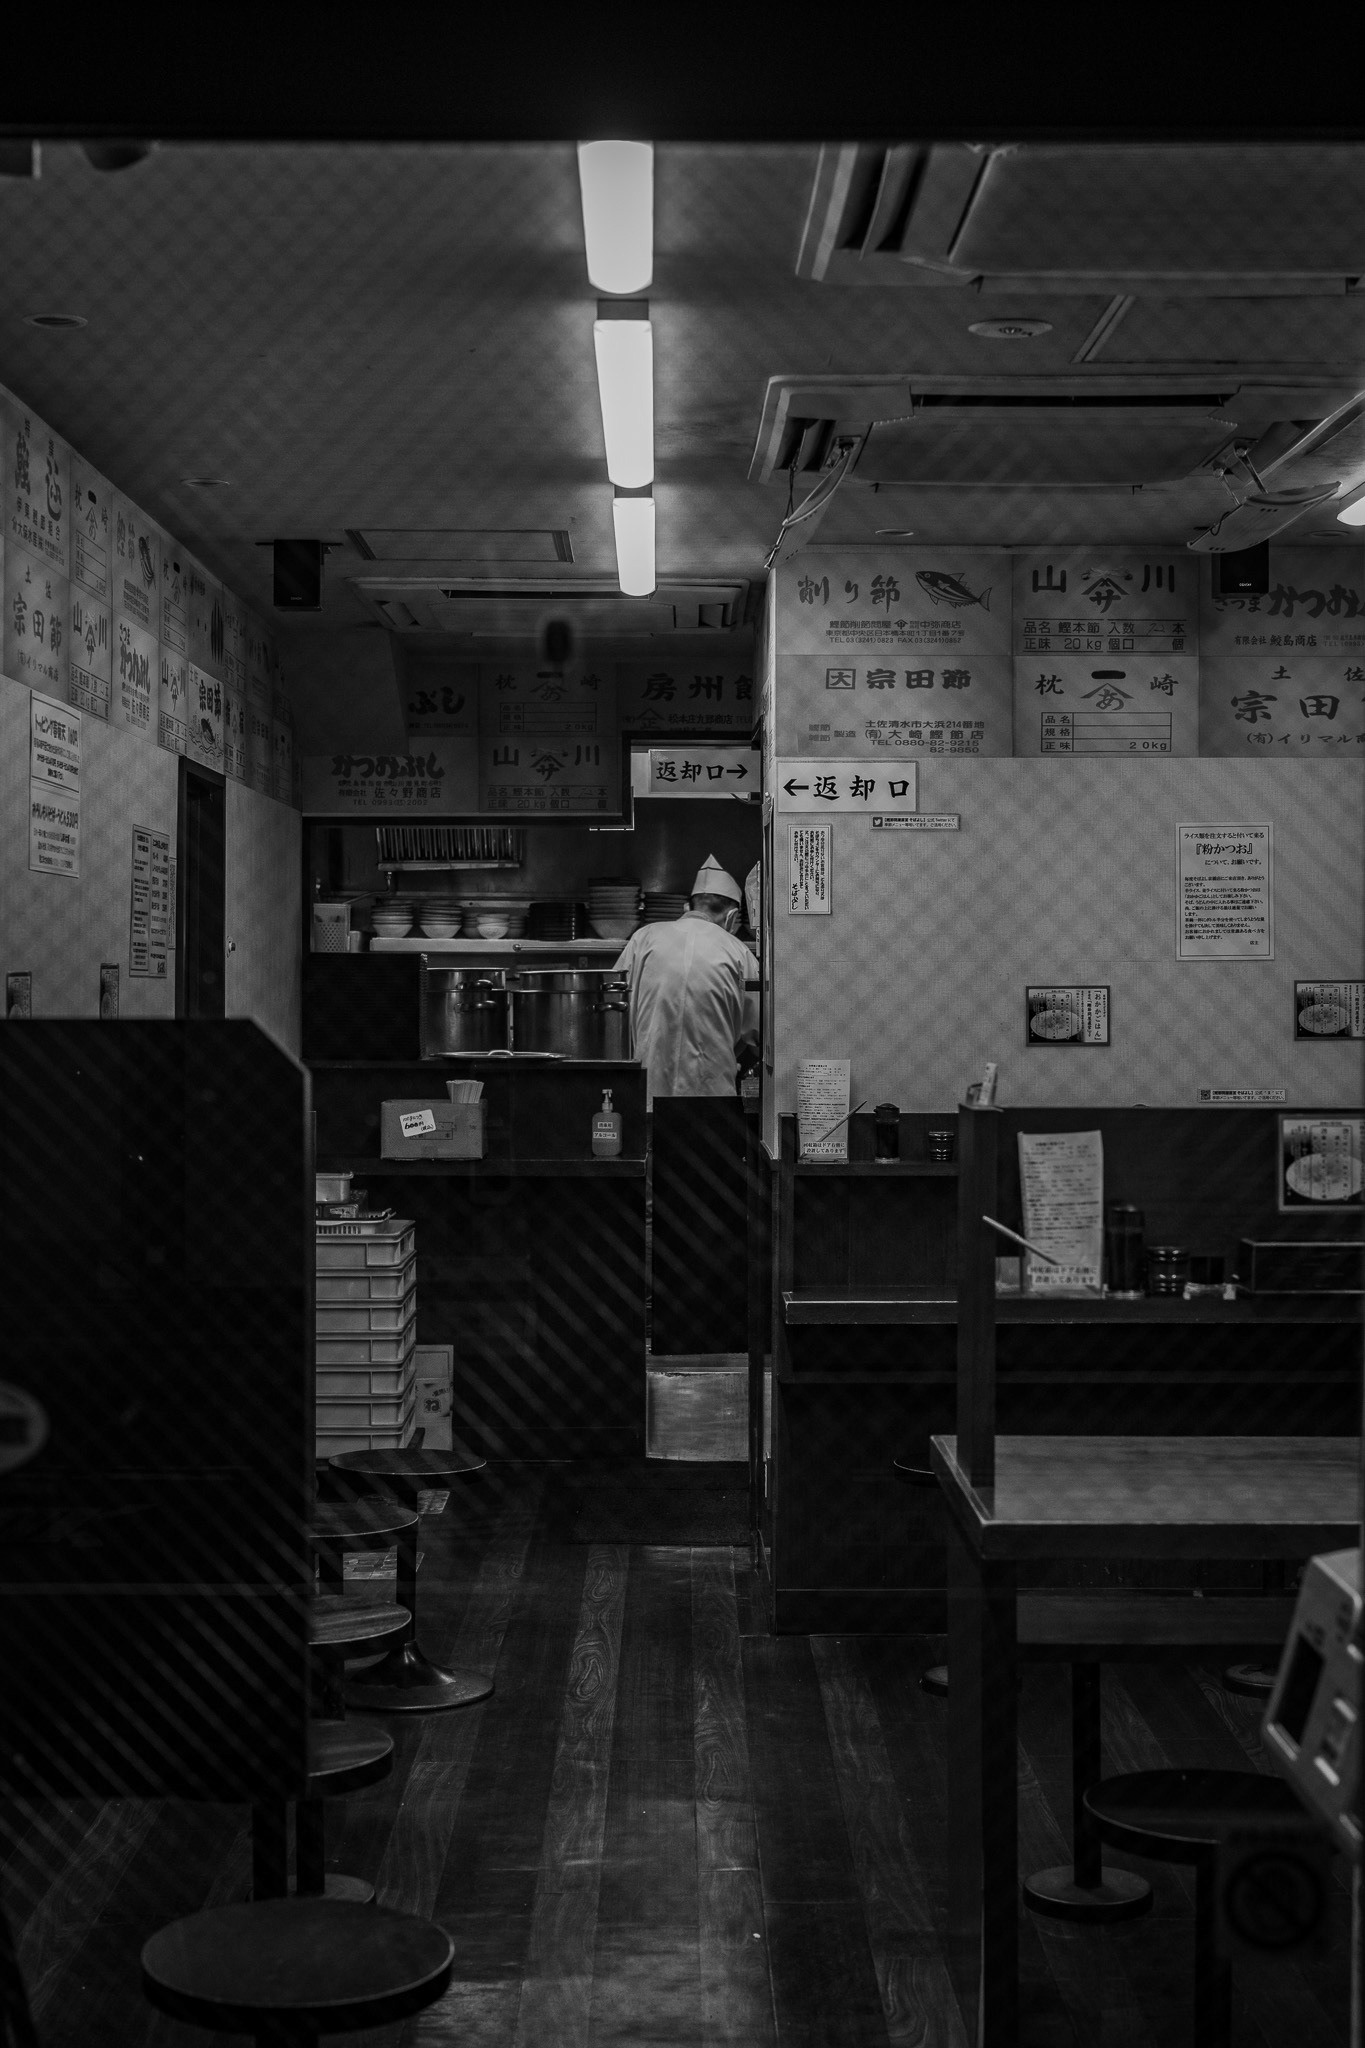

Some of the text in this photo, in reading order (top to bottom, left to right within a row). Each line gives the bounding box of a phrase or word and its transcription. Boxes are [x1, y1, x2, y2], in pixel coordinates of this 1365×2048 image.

[797, 574, 901, 613] 削り節
[1214, 598, 1262, 613] さつま
[1024, 621, 1051, 634] 品名
[1058, 621, 1101, 634] 鰹本節
[1108, 621, 1135, 634] 入数
[1024, 637, 1051, 650] 正味
[1108, 638, 1135, 650] 個口
[865, 668, 972, 690] 宗田節
[1230, 690, 1365, 723] 宗田
[1044, 715, 1071, 724] 品名
[1044, 727, 1071, 737] 規格
[1044, 741, 1071, 750] 正味
[656, 760, 725, 782] 返却口
[813, 775, 910, 801] 返却口
[1184, 832, 1265, 840] ライス類を注文すると付いて来る
[1195, 843, 1253, 855] 『粉かつお』
